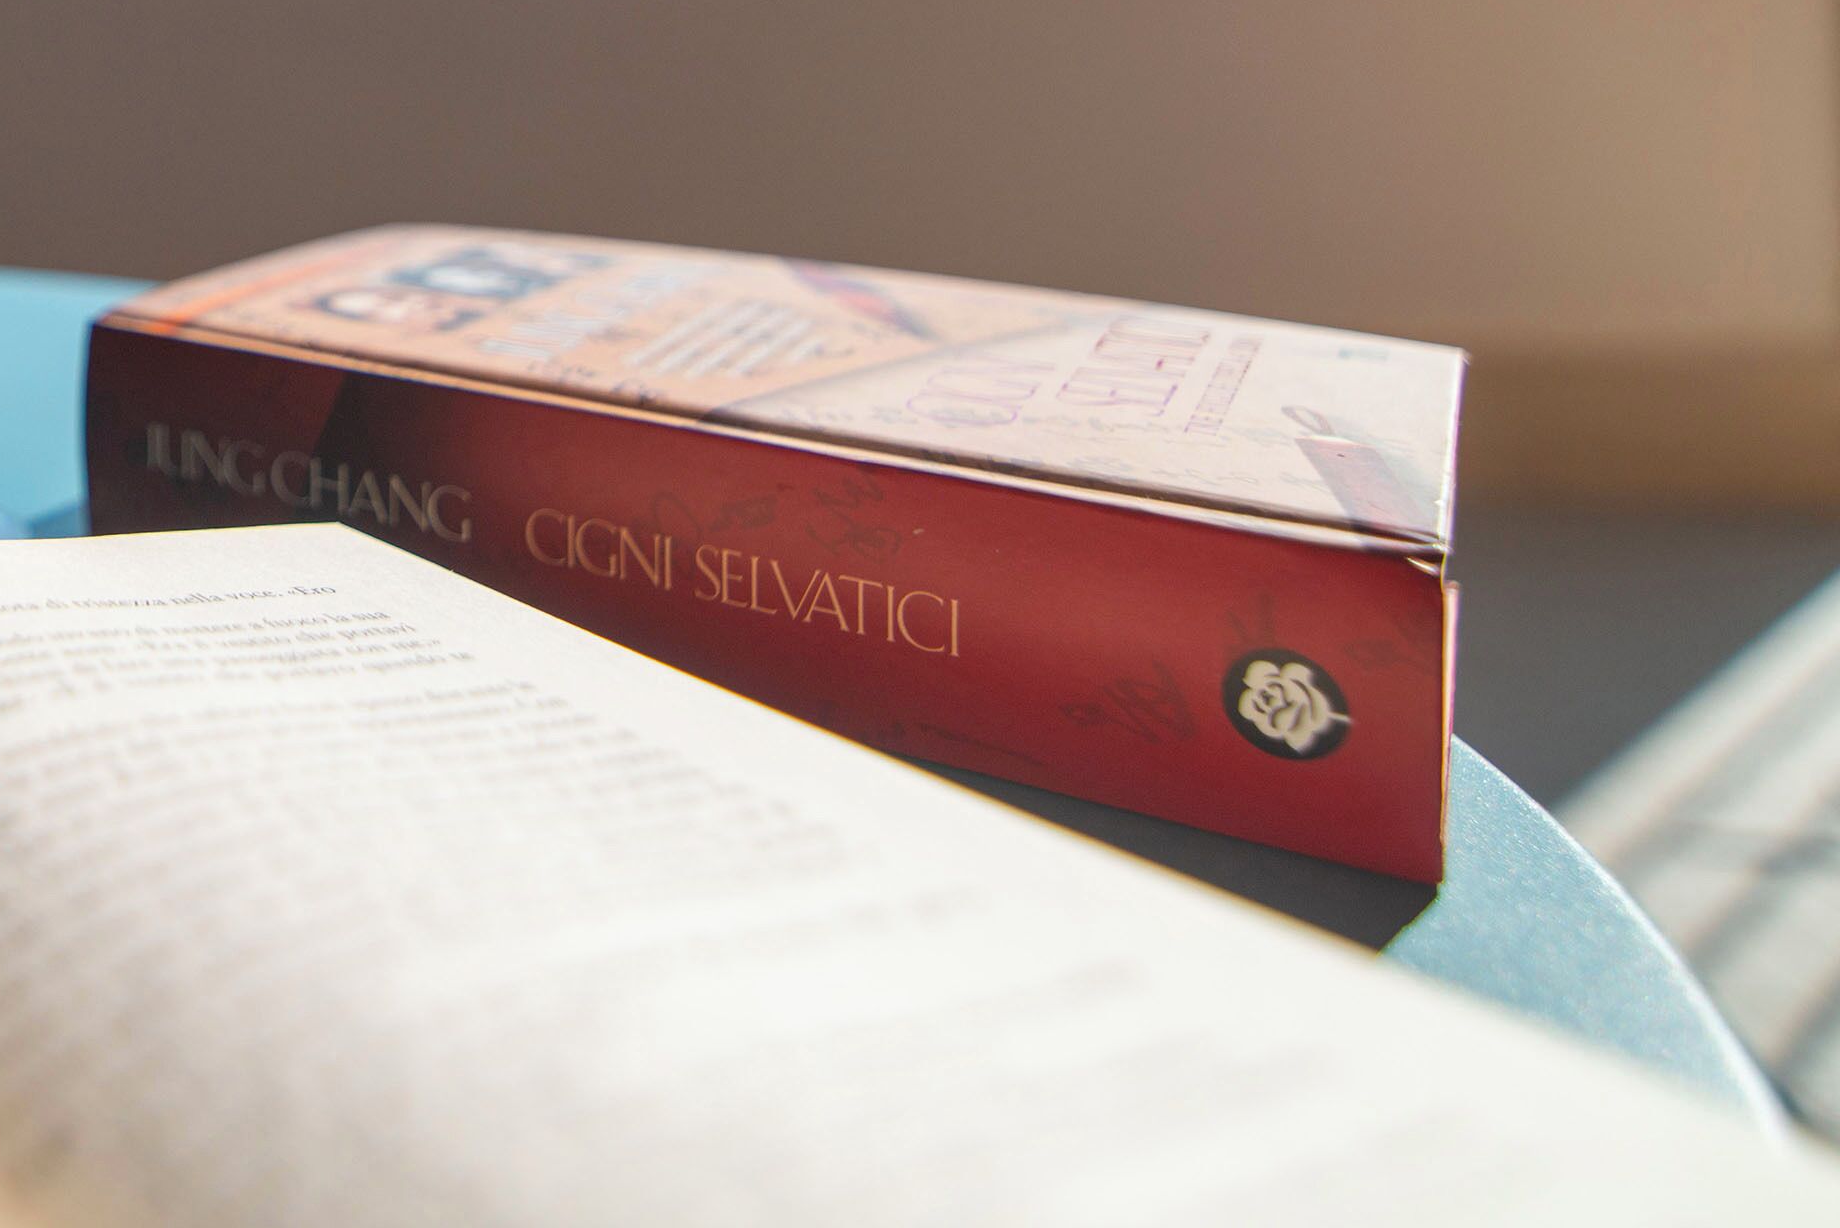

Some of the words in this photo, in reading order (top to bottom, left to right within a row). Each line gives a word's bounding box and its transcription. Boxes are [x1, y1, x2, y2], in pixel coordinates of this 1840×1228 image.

[270, 449, 473, 544] CHANG
[170, 591, 224, 606] nella
[523, 506, 674, 592] CIGNI
[694, 543, 961, 658] SELVATICI
